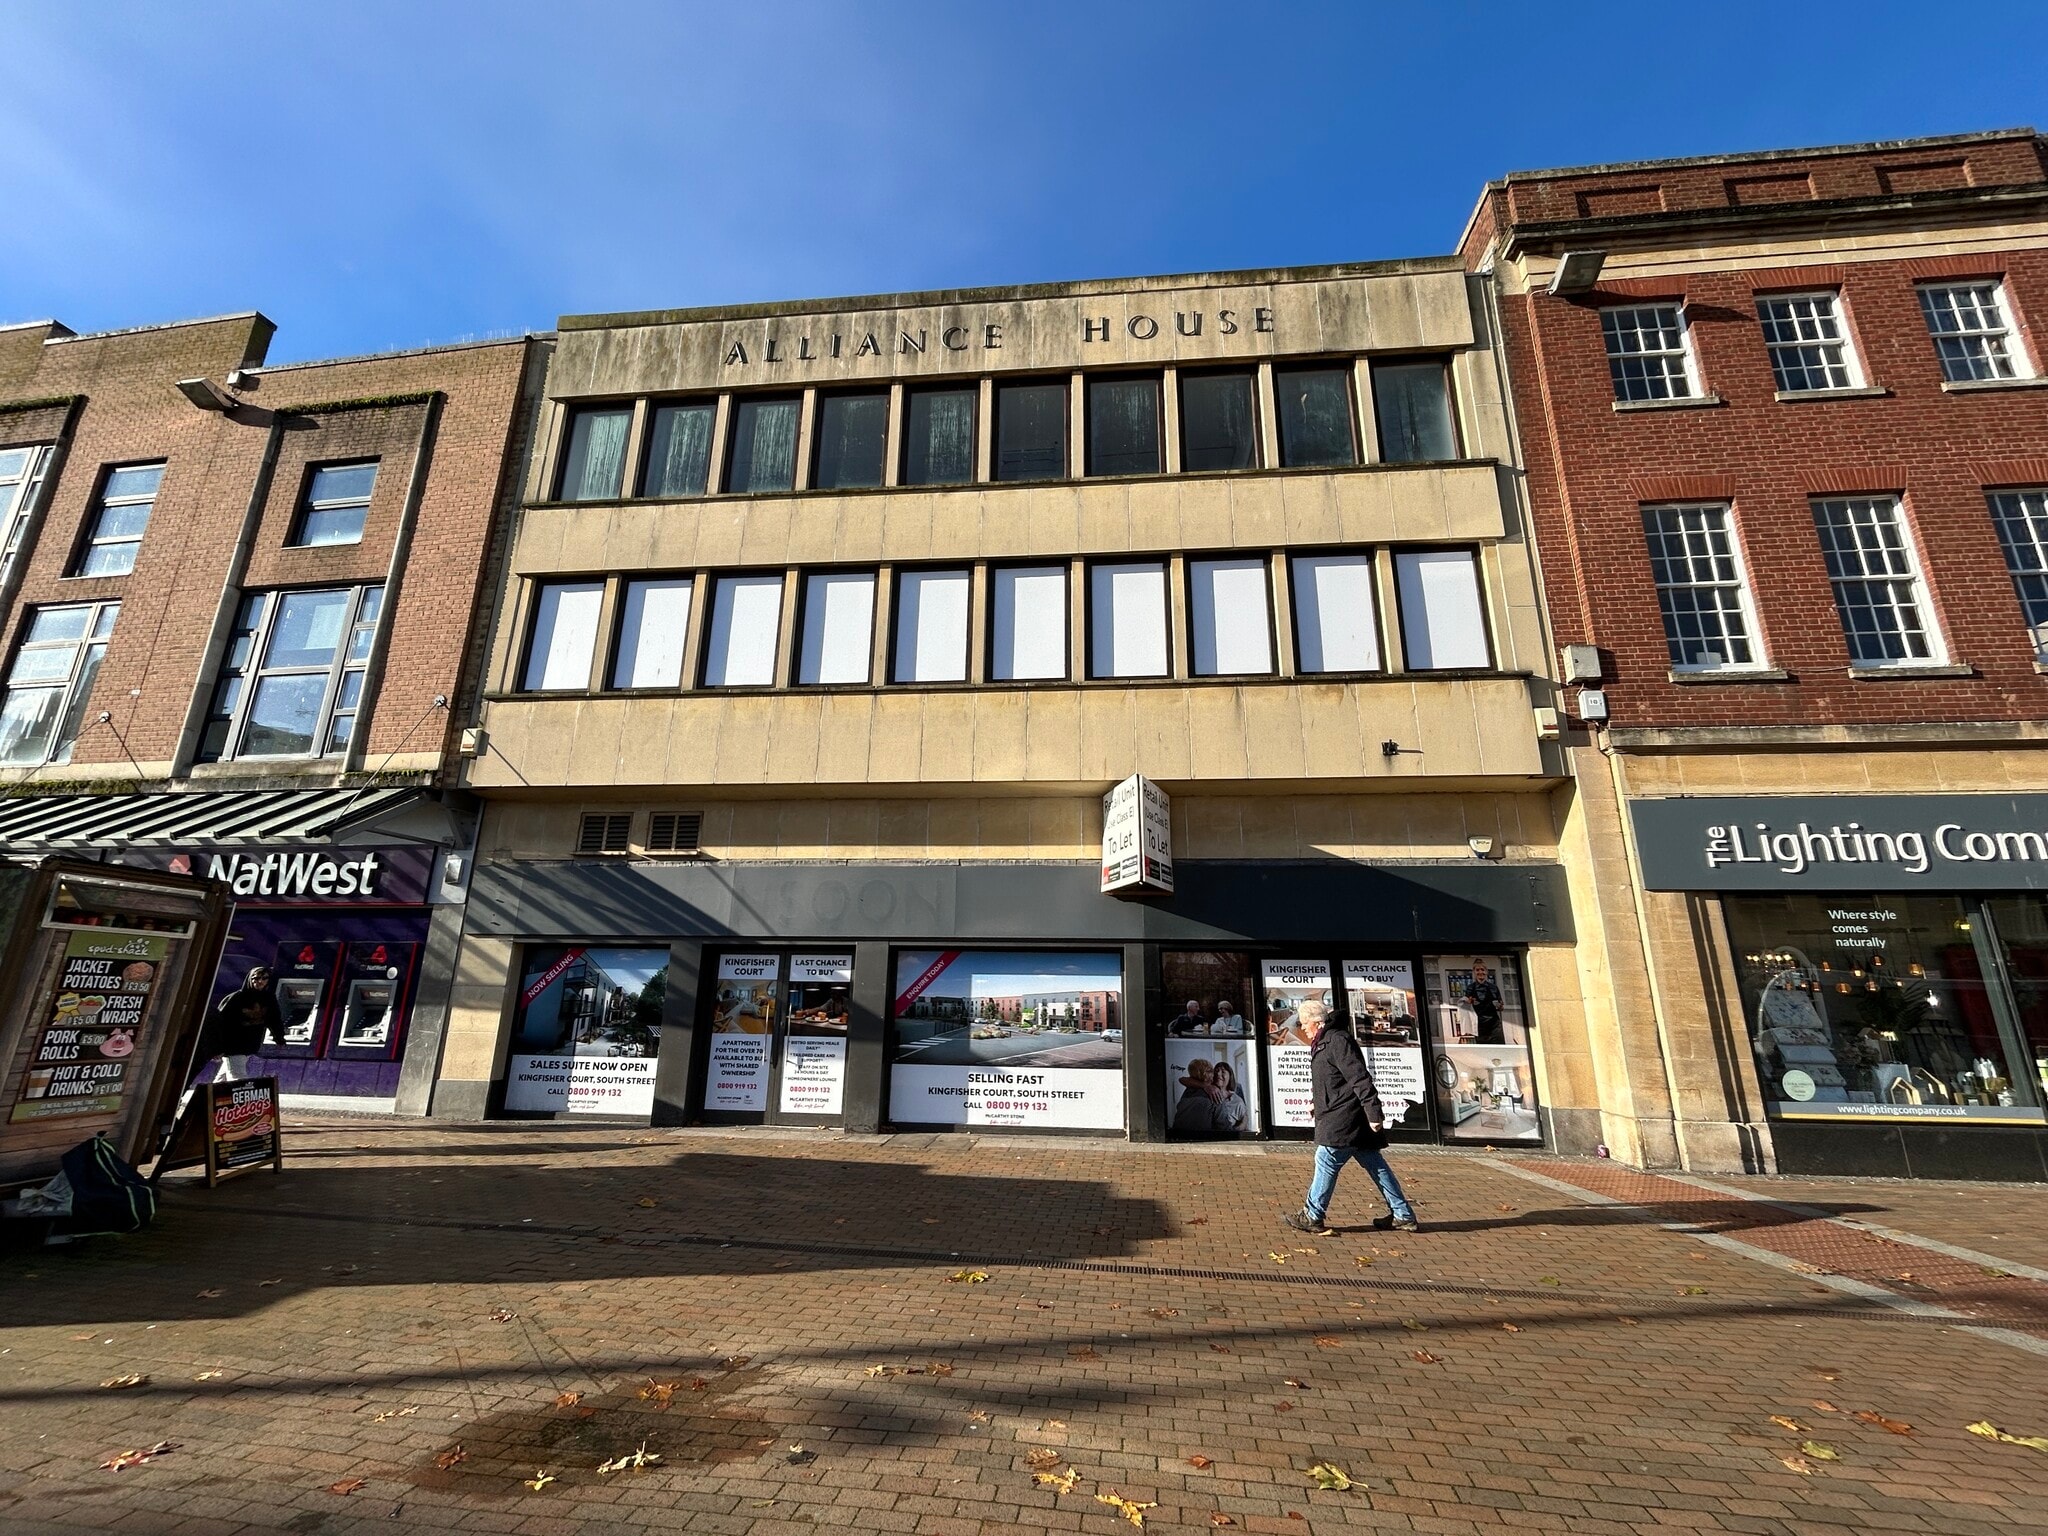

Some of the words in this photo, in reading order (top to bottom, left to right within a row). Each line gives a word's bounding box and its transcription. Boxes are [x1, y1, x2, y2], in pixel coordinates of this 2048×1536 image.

[723, 324, 1003, 366] ALLIANCE
[1083, 307, 1275, 343] HOUSE
[1121, 784, 1135, 803] Unit
[1143, 783, 1157, 805] Retail
[1108, 837, 1118, 856] To
[1119, 829, 1133, 851] Let
[1147, 828, 1156, 850] To
[1157, 833, 1169, 856] Let
[1704, 825, 1727, 868] The
[1729, 822, 1930, 874] Lighting
[1935, 824, 2048, 861] Com
[208, 851, 379, 896] NatWest
[1828, 909, 1868, 921] Where
[1869, 909, 1897, 922] style
[1832, 925, 1869, 934] comes
[1835, 936, 1886, 949] naturally
[67, 960, 113, 974] JACKET
[725, 958, 776, 967] KINGFISHER
[815, 959, 847, 967] CHANCE
[1269, 965, 1327, 974] KINGFISHER
[1371, 965, 1407, 973] CHANCE
[527, 979, 547, 998] NOW
[545, 953, 574, 982] SELLING
[734, 968, 764, 976] COURT
[1376, 975, 1394, 983] BUY
[62, 975, 122, 990] POTATOES
[905, 976, 929, 999] ENQUIRE
[927, 960, 945, 978] TODAY
[1282, 975, 1315, 984] COURT
[106, 995, 144, 1010] FRESH
[100, 1010, 141, 1024] WRAPS
[44, 1030, 80, 1044] PORK
[39, 1045, 80, 1060] ROLLS
[54, 1065, 81, 1080] HOT
[81, 1065, 91, 1079] &
[92, 1064, 122, 1078] COLD
[530, 1060, 560, 1070] SALES
[562, 1061, 590, 1070] SUITE
[592, 1062, 618, 1071] NOW
[620, 1062, 648, 1072] OPEN
[518, 1073, 565, 1083] KINGFISHER
[566, 1075, 596, 1084] COURT,
[596, 1076, 625, 1084] SOUTH
[626, 1077, 656, 1085] STREET
[967, 1073, 1014, 1085] SELLING
[1016, 1075, 1044, 1085] FAST
[48, 1080, 95, 1097] DRINKS
[232, 1087, 270, 1104] GERMAN
[567, 1087, 589, 1096] 0800
[591, 1088, 606, 1096] 919
[608, 1089, 622, 1097] 132
[928, 1086, 981, 1096] KINGFISHER
[982, 1088, 1016, 1098] COURT,
[1017, 1089, 1049, 1098] SOUTH
[1050, 1091, 1085, 1099] STREET
[215, 1098, 271, 1125] Hotdogs
[963, 1101, 983, 1109] CALL
[986, 1100, 1011, 1110] 0800
[1013, 1101, 1030, 1110] 919
[1032, 1102, 1048, 1111] 132
[1837, 1104, 1967, 1117] www.lightingcompany.co.uk
